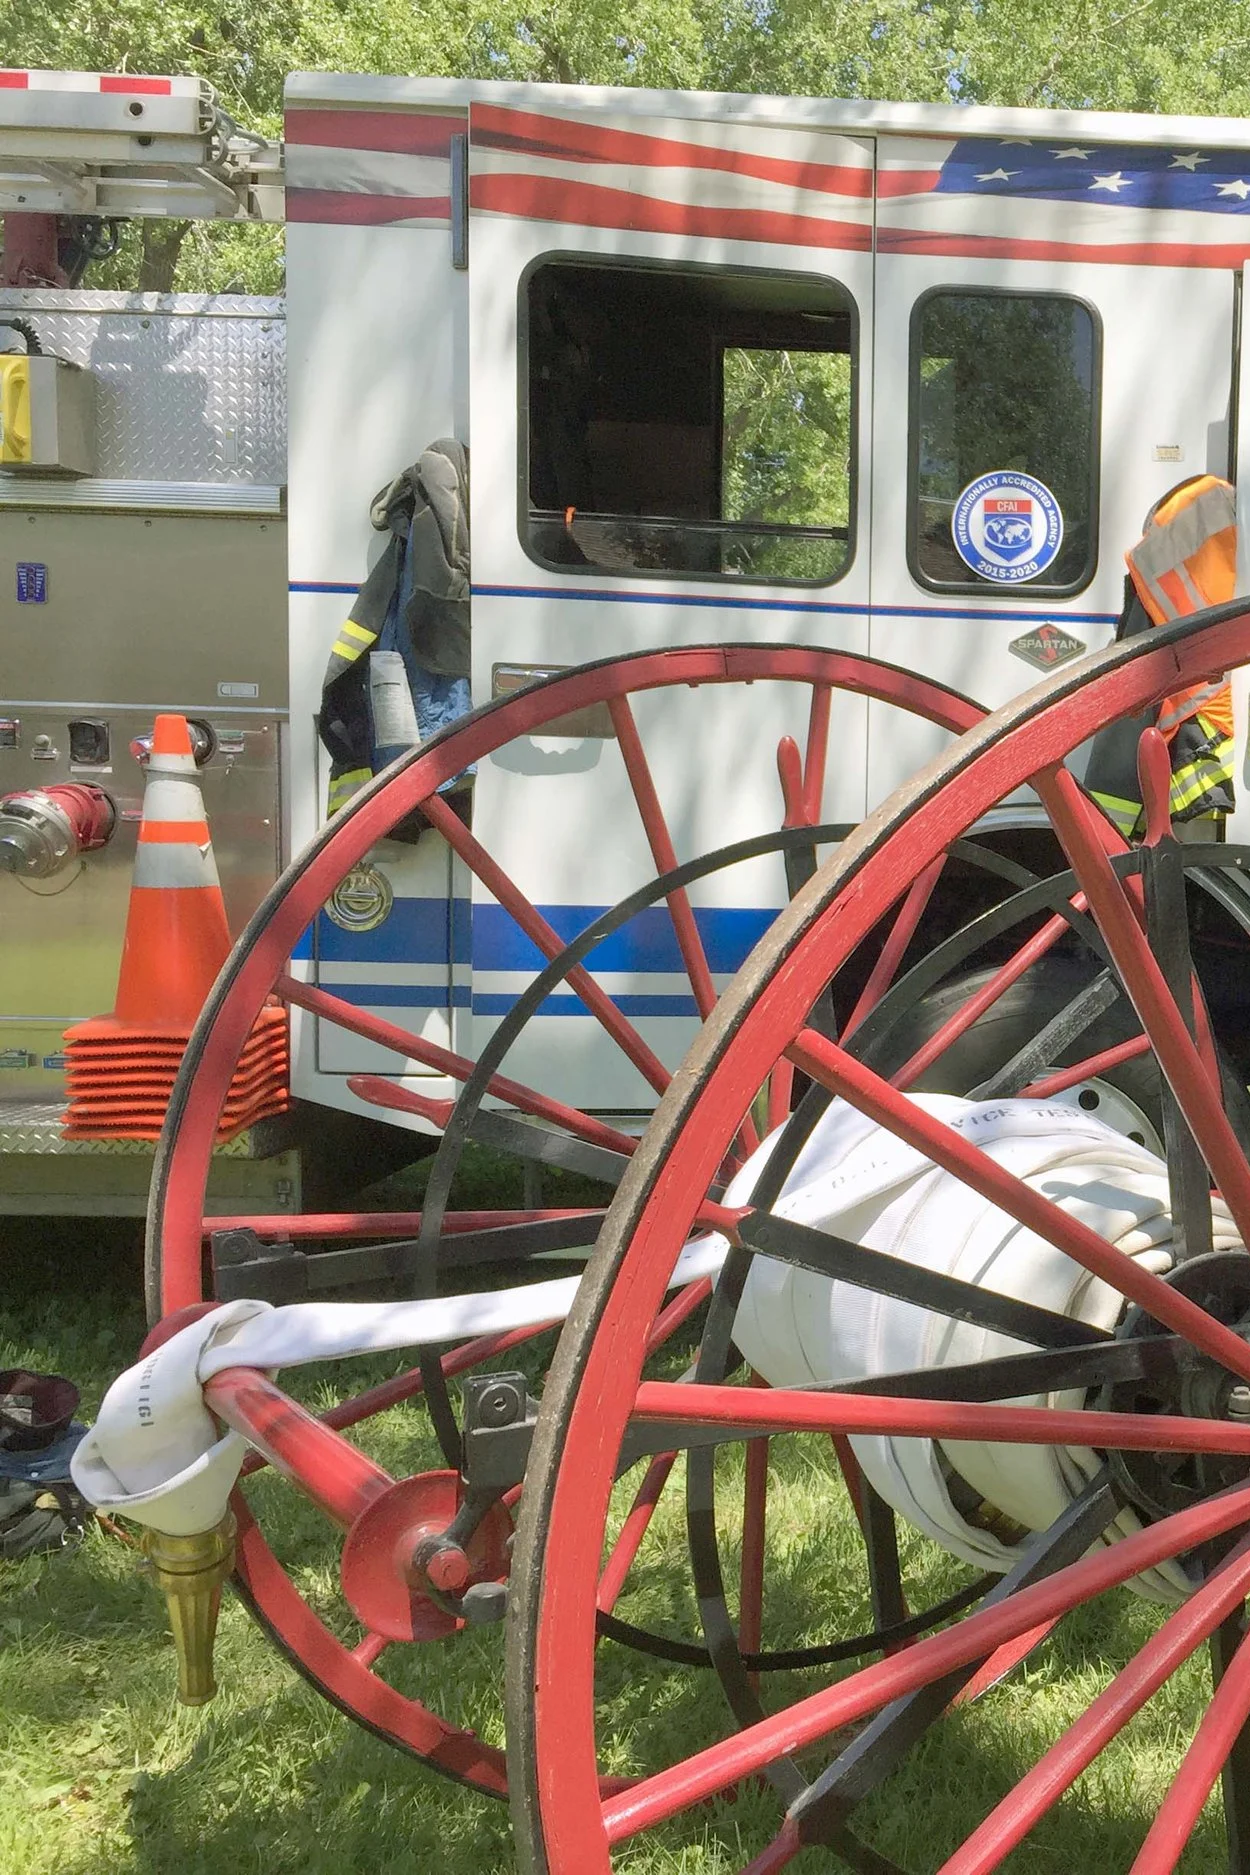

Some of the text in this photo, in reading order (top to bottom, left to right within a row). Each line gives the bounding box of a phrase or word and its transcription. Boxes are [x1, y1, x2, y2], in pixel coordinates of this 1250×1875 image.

[957, 476, 1059, 548] INTERNATIONALLY ACCREDITED AGENCY
[996, 501, 1018, 512] CFAI
[1018, 639, 1078, 650] SPARTAN
